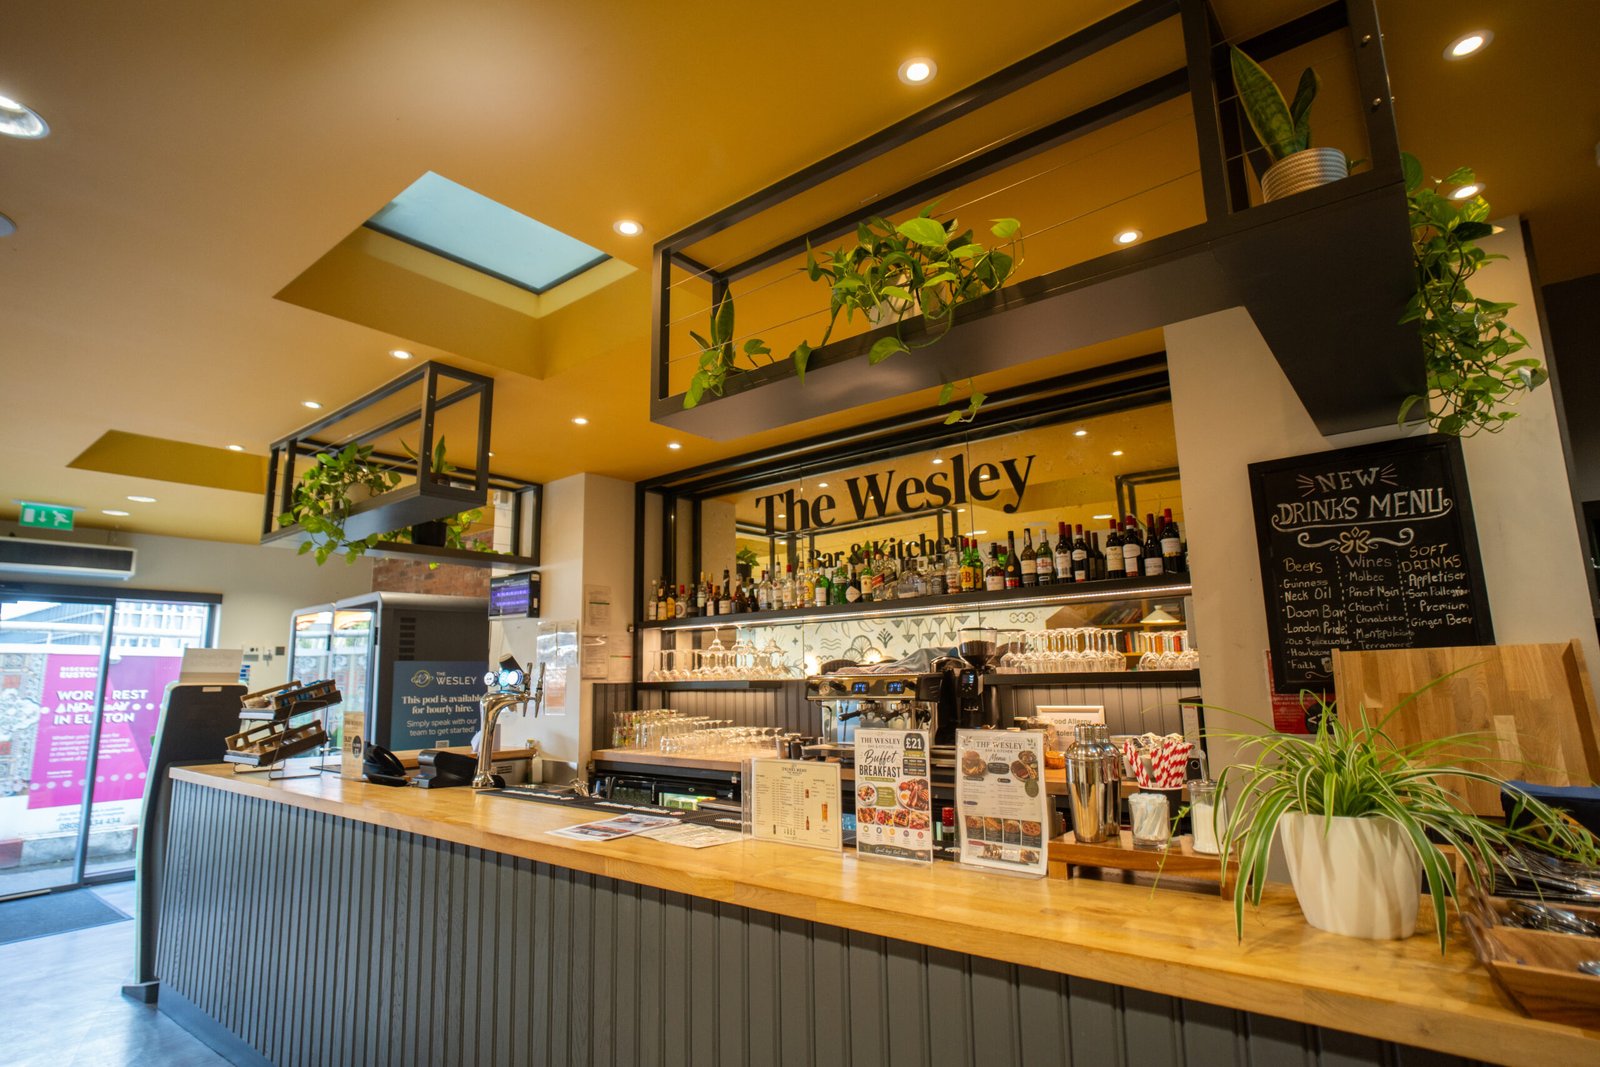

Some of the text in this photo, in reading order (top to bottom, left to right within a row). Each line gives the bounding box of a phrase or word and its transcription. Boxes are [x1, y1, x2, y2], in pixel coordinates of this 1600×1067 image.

[1315, 468, 1380, 492] NEW
[755, 454, 1036, 535] The Wesley
[1276, 488, 1444, 525] DRINKS MENU
[808, 548, 844, 568] Bar
[850, 543, 864, 565] &
[1410, 543, 1448, 558] SOFT
[1283, 558, 1323, 574] Beers
[1346, 555, 1392, 568] Wines
[1401, 555, 1462, 572] DRINKS
[1409, 572, 1466, 589] Appletiser
[1285, 586, 1332, 602] Neck Oil
[1349, 585, 1374, 597] Pinot
[1286, 604, 1344, 618] Doom Bar
[1420, 600, 1469, 612] Premium
[1446, 614, 1472, 626] Beer
[1287, 621, 1345, 635] London Pride
[436, 676, 477, 685] WESLEY
[57, 690, 148, 701] WOR, REST
[402, 696, 420, 704] This
[423, 695, 438, 705] pod
[412, 706, 424, 714] for
[426, 705, 452, 715] hourly
[54, 713, 135, 725] IN EUTON
[407, 720, 430, 728] Simply
[432, 719, 450, 727] speak
[906, 738, 922, 749] £21
[864, 749, 899, 765] Buffet
[860, 765, 901, 778] BREAKFAST
